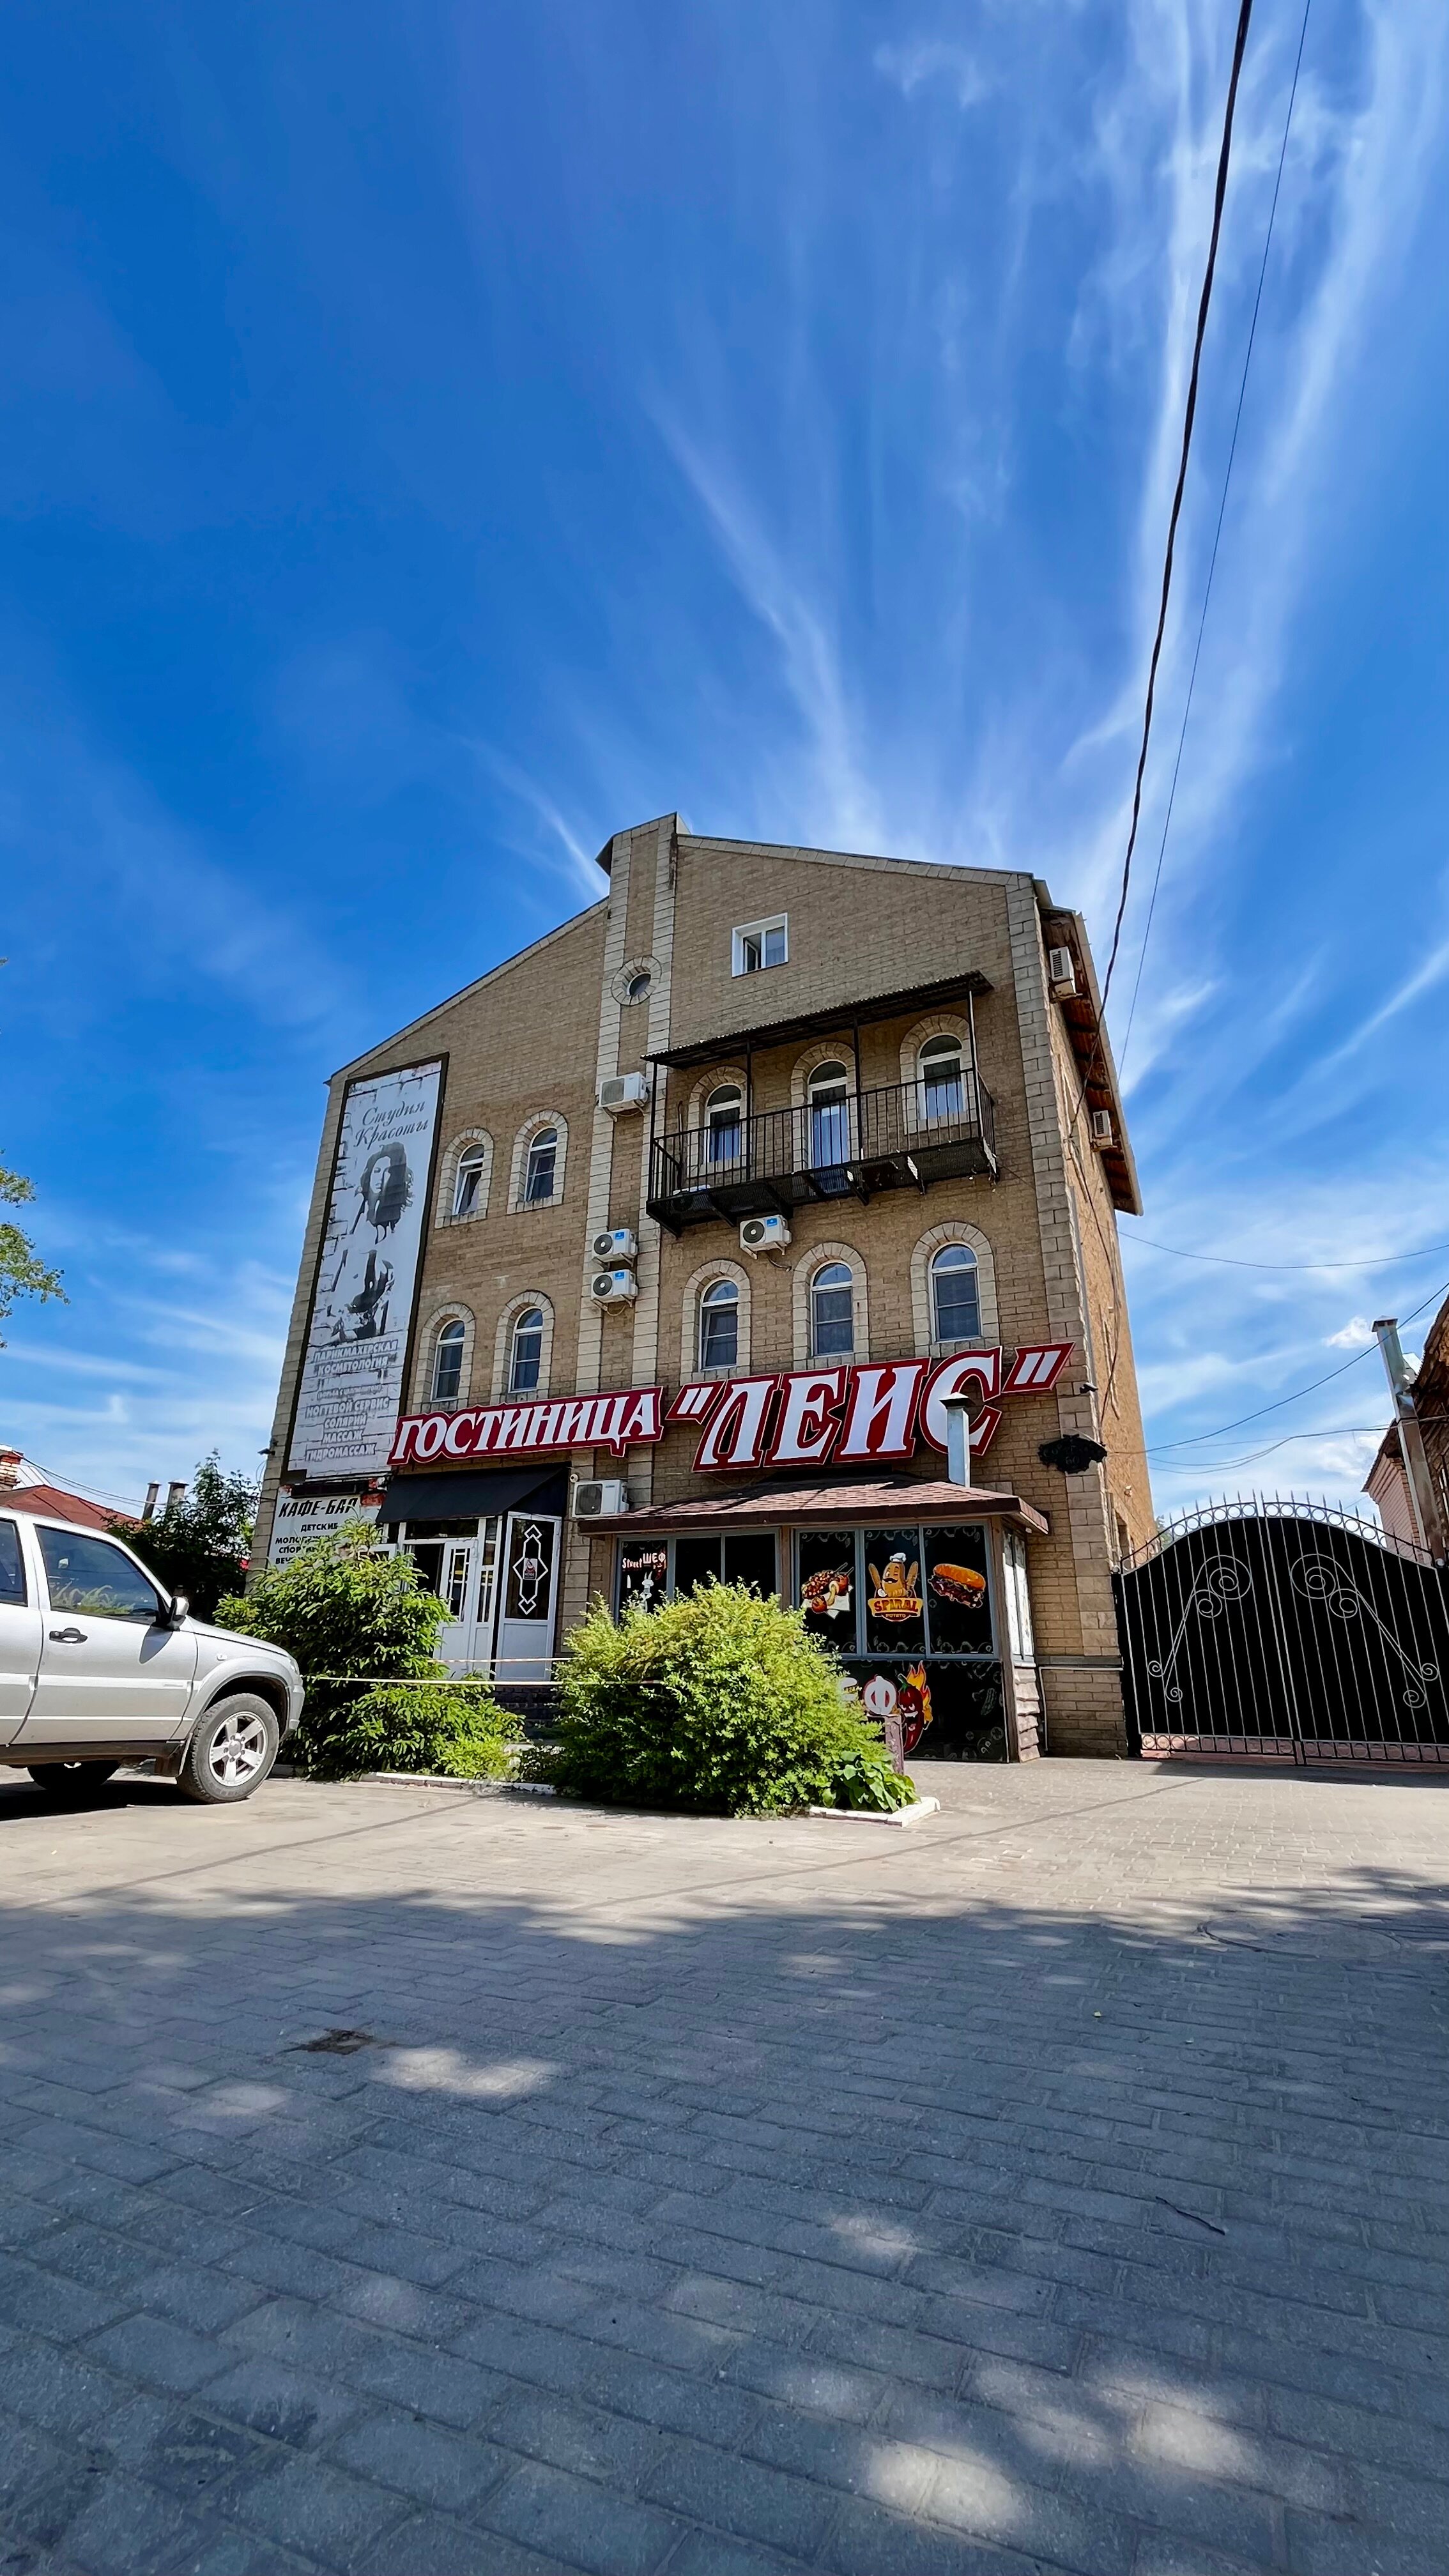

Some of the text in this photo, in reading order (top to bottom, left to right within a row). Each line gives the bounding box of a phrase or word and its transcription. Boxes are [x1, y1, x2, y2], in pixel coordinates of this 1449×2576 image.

[362, 1101, 425, 1127] Студия
[353, 1120, 429, 1150] Красоты
[314, 1340, 398, 1361] ПАРИКМАХЕРСКАЯ
[318, 1356, 389, 1375] КОСМЕТОЛОГИЯ
[305, 1397, 390, 1418] НОГТЕВОЙ СЕРВИС
[324, 1413, 367, 1429] СОЛЯРИЙ
[393, 1393, 656, 1459] ГОСТИНИЦА
[321, 1429, 365, 1445] МАССАЖ
[305, 1443, 377, 1462] ГИДРОМАССАЖ
[278, 1498, 358, 1518] КАФЕ-БАР
[643, 1552, 666, 1564] ШЕФ
[874, 1598, 918, 1612] SPIRAL
